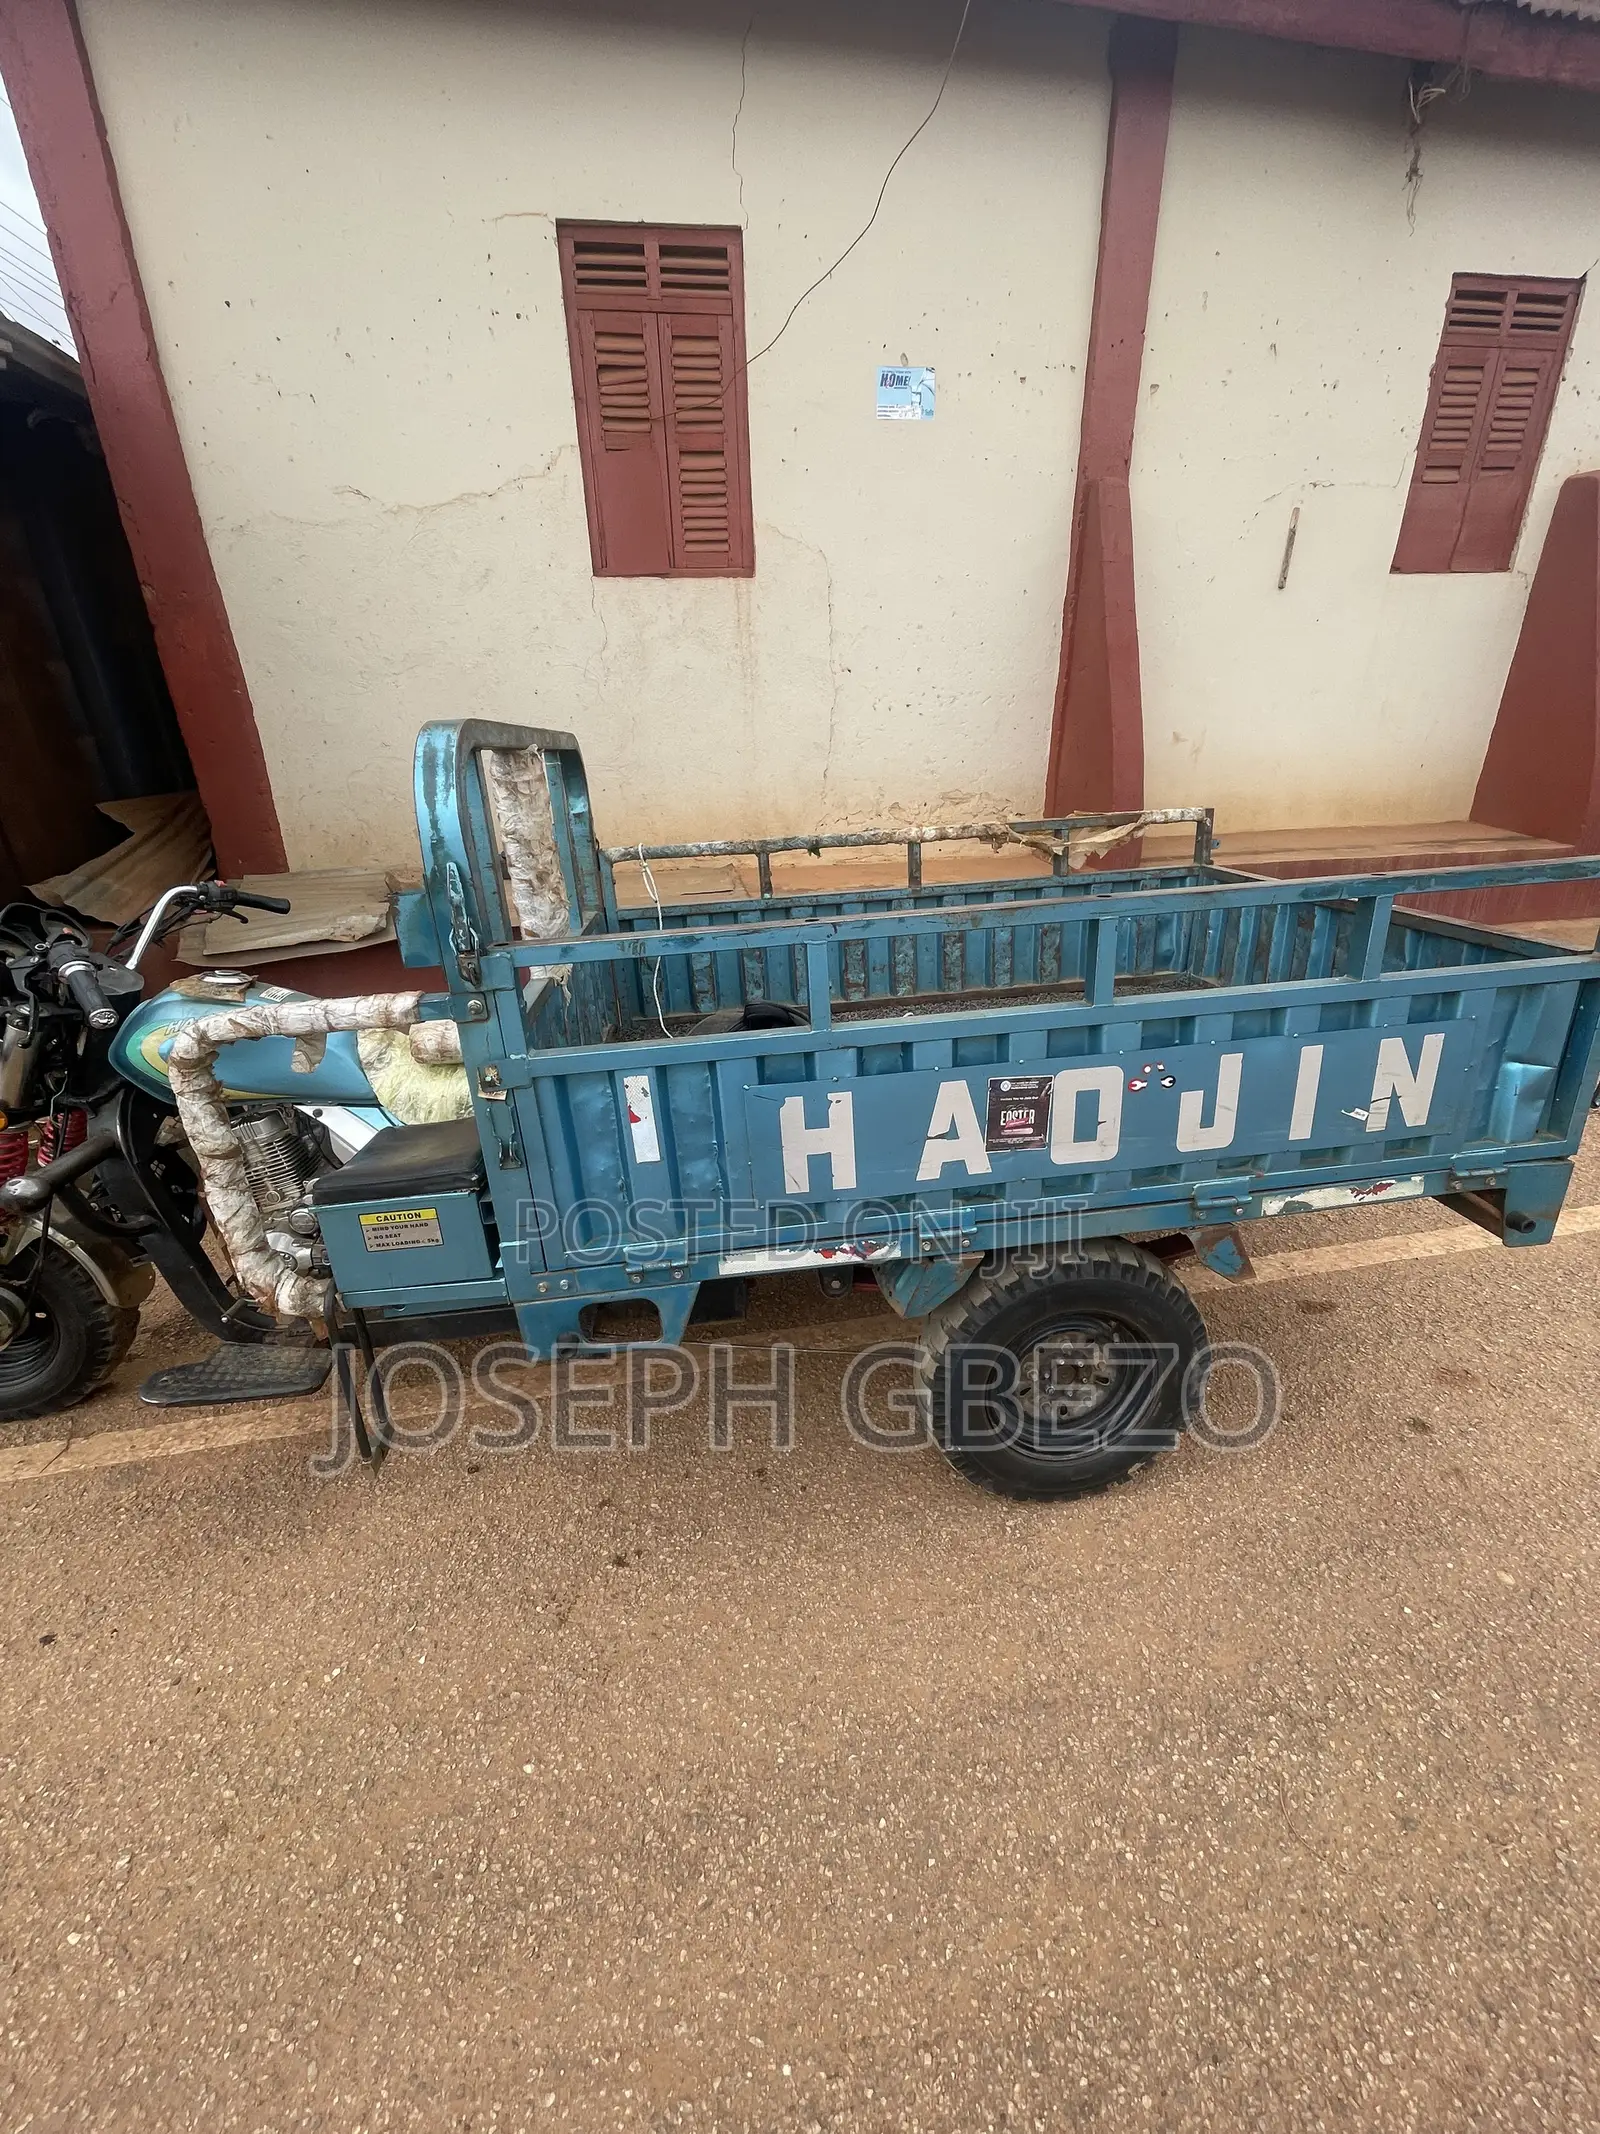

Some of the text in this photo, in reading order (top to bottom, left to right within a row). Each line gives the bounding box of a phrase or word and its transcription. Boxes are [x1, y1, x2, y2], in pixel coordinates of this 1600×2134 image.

[780, 1032, 1445, 1194] HAOJIN
[1001, 1109, 1035, 1126] EASTER
[376, 1212, 421, 1222] CAUTION
[392, 1239, 421, 1247] LOADING
